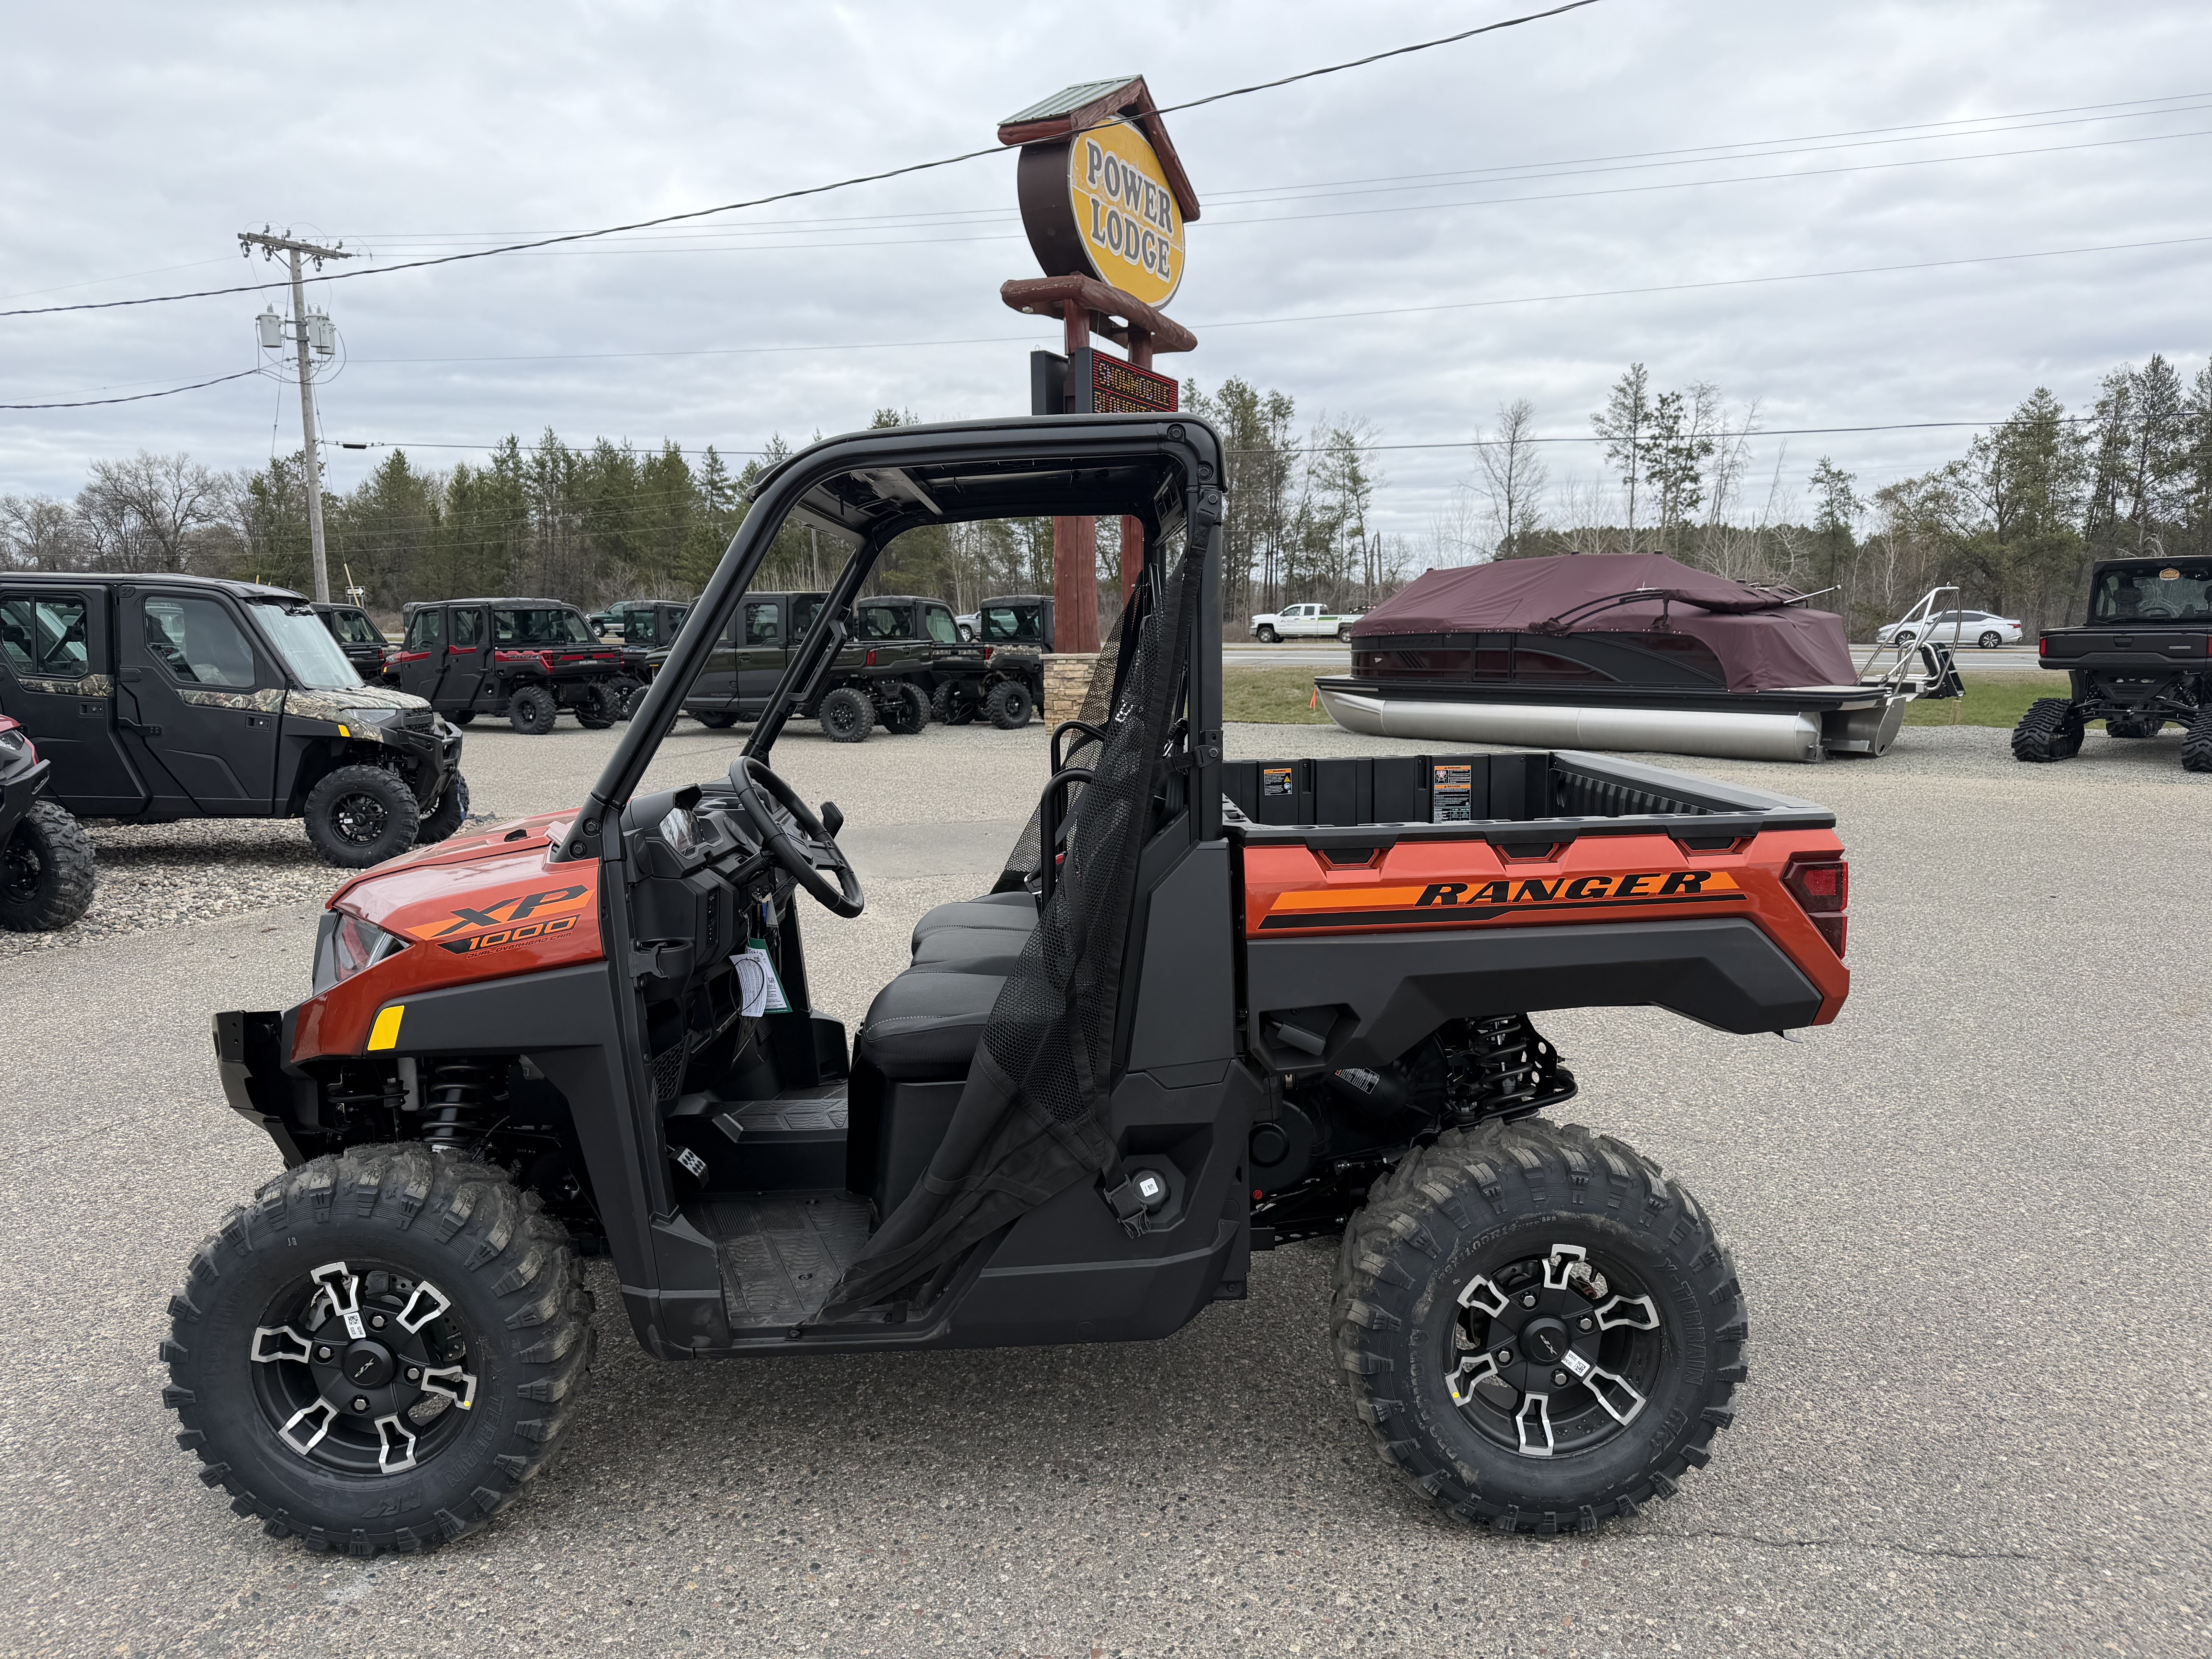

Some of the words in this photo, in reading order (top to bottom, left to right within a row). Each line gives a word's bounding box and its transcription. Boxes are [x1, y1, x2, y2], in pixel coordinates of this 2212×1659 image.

[1087, 139, 1173, 235] POWER
[1090, 196, 1170, 281] LODGE
[1099, 362, 1170, 406] SNOWMOBILE
[1414, 871, 1711, 907] RANGER
[429, 885, 588, 938] XP
[467, 949, 493, 958] DUAL
[496, 938, 548, 952] OVERHEAD
[469, 916, 577, 950] 1000
[1655, 1255, 1704, 1384] X-TERRAIN
[1540, 1334, 1558, 1355] XP
[355, 1358, 374, 1377] XP
